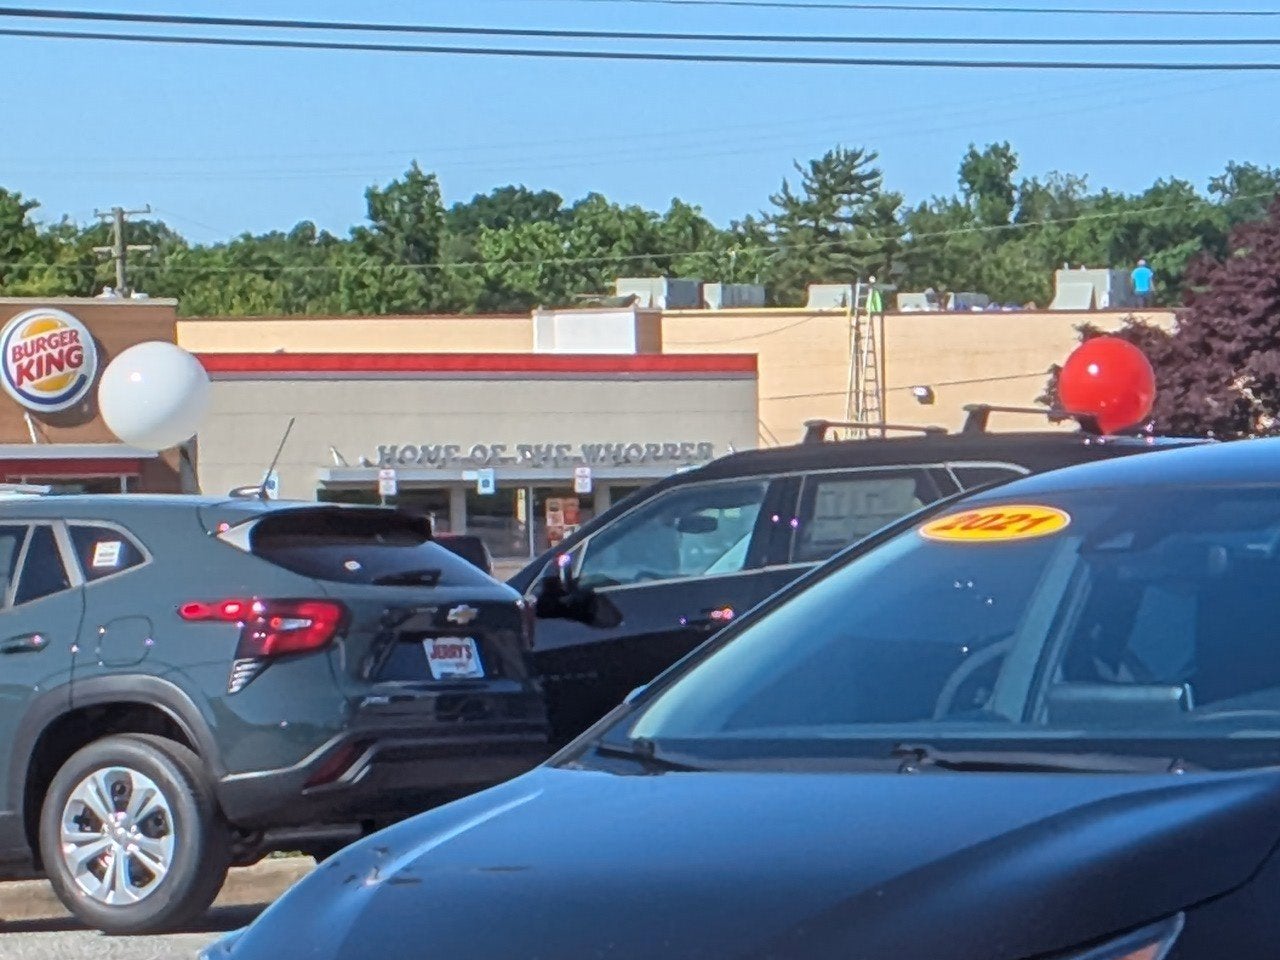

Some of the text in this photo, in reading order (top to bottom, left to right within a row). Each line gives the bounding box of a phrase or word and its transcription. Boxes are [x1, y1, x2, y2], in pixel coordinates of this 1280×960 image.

[12, 329, 79, 363] BURGER
[16, 345, 84, 386] KING
[377, 441, 714, 467] HOME OF THE WHOPPER
[931, 513, 1057, 533] 2021
